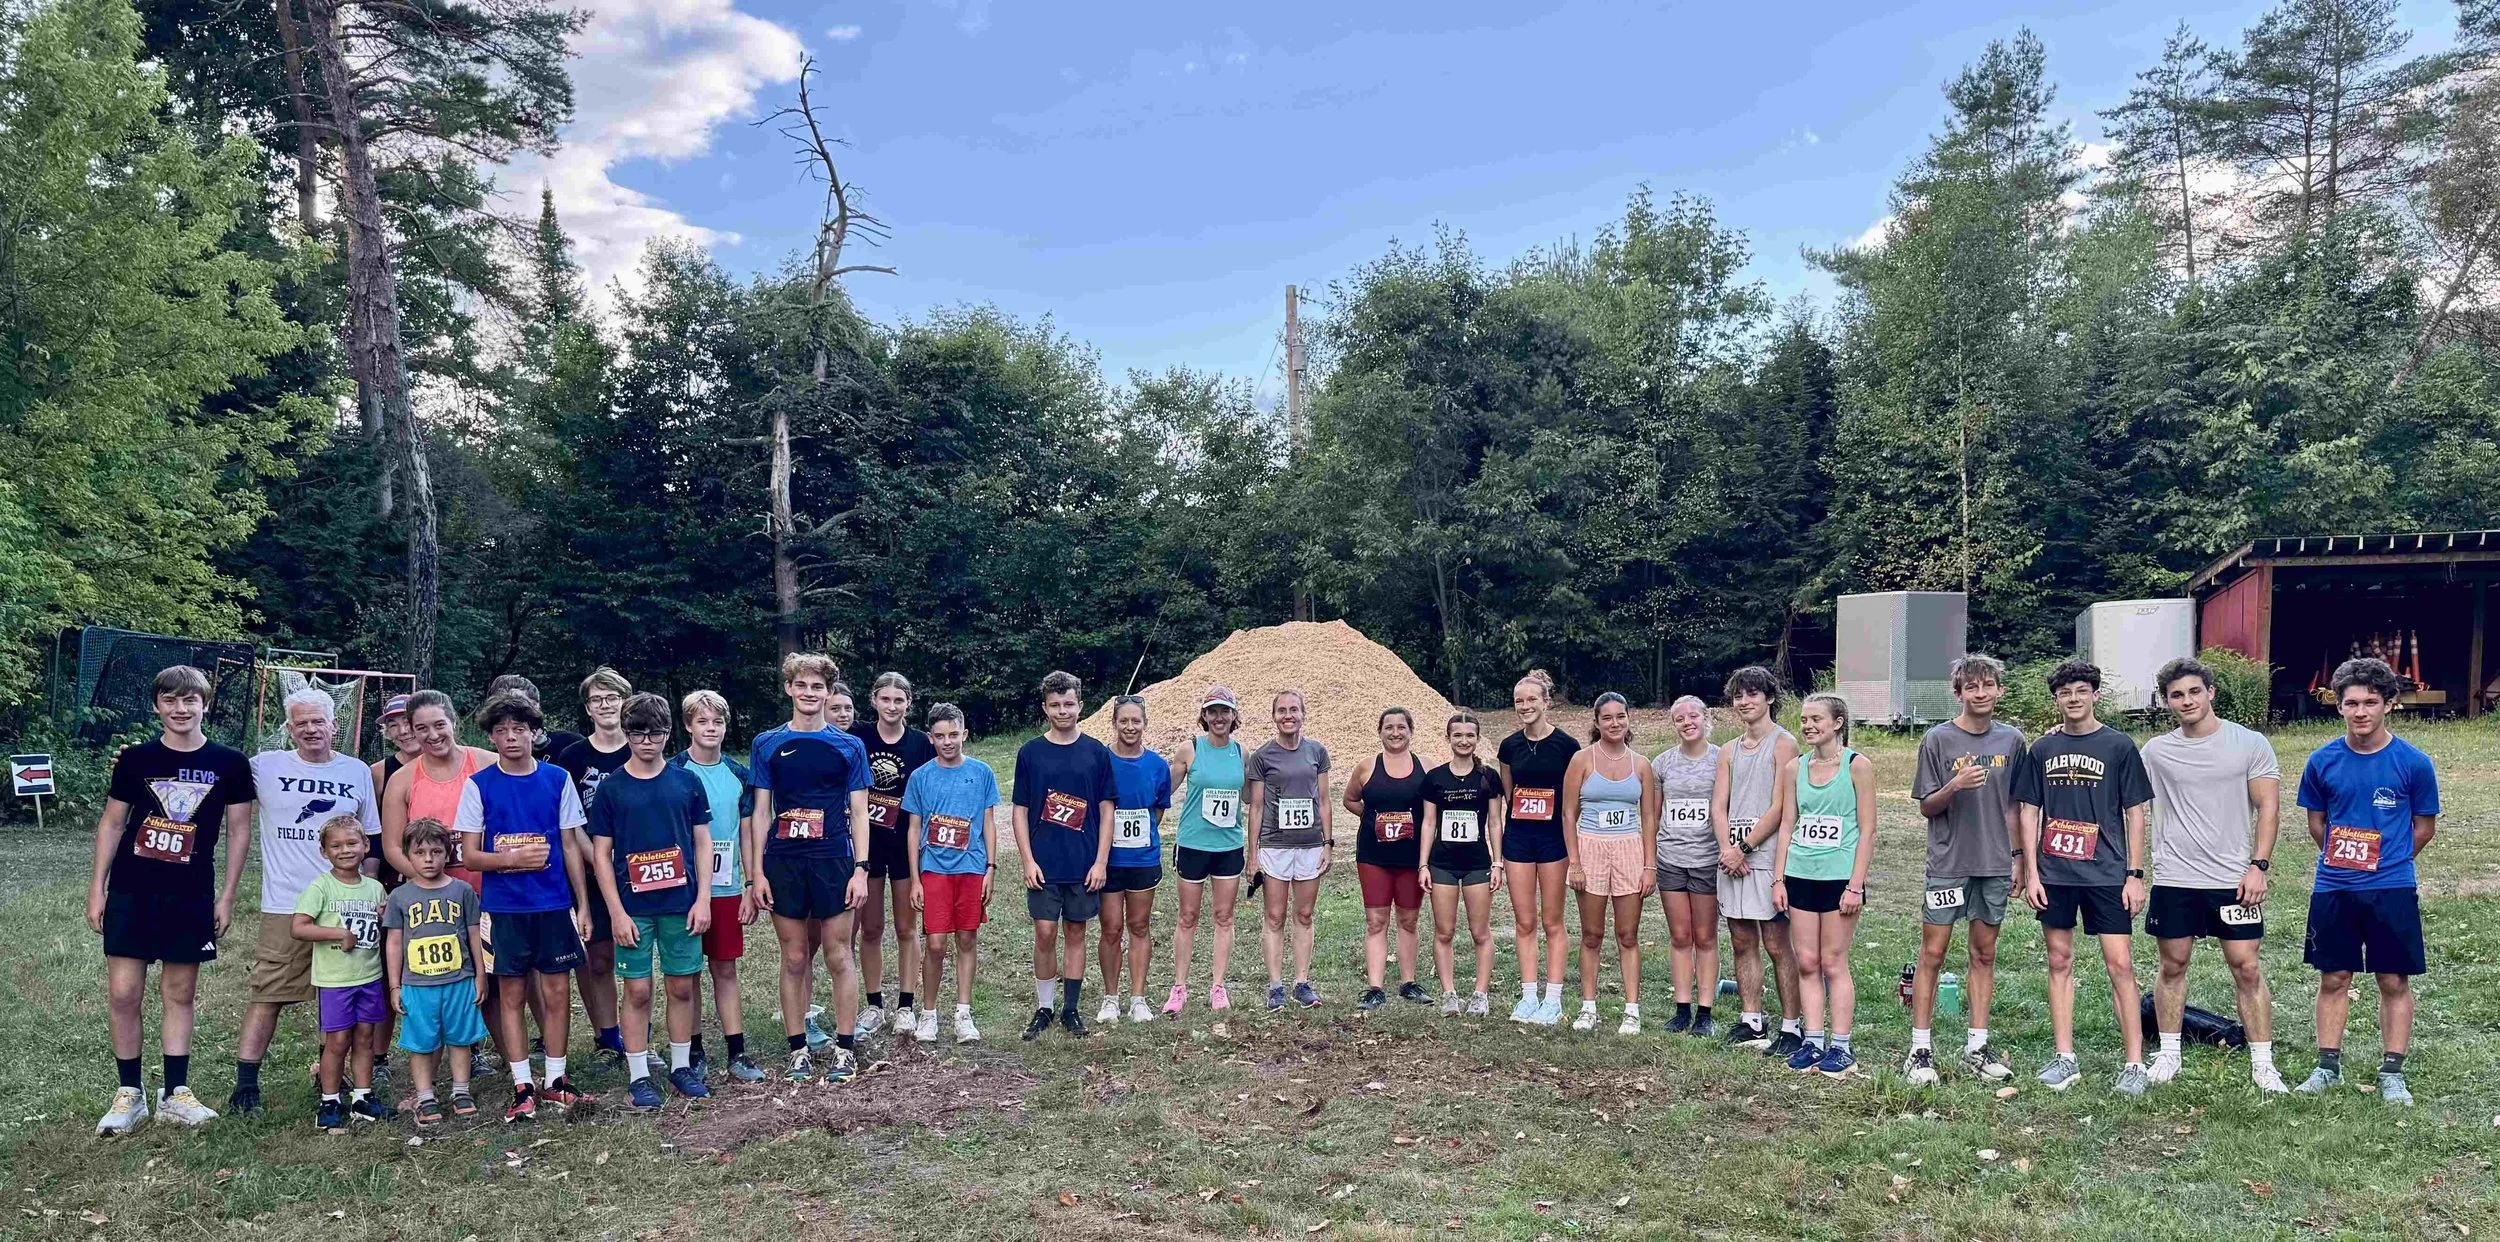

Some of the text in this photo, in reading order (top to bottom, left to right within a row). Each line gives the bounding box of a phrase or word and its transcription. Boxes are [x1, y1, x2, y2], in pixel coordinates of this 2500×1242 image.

[2045, 753, 2105, 776] HARWOOD
[278, 776, 355, 800] YORK
[1052, 804, 1075, 823] 27
[1212, 800, 1230, 817] 79
[1520, 799, 1546, 814] 250
[1670, 808, 1706, 821] 1645
[1285, 809, 1309, 826] 155
[1606, 810, 1625, 826] 487
[277, 827, 315, 841] FIELD &
[789, 821, 809, 839] 64
[937, 826, 956, 844] 81
[1123, 820, 1140, 838] 86
[1385, 823, 1402, 839] 67
[1451, 821, 1468, 839] 81
[1801, 824, 1839, 840] 1652
[144, 829, 184, 854] 396
[2050, 832, 2085, 855] 431
[2334, 839, 2369, 861] 253
[639, 861, 675, 883] 255
[1934, 889, 1957, 907] 318
[408, 899, 461, 929] GAP
[2226, 907, 2259, 921] 1348
[417, 941, 453, 965] 188
